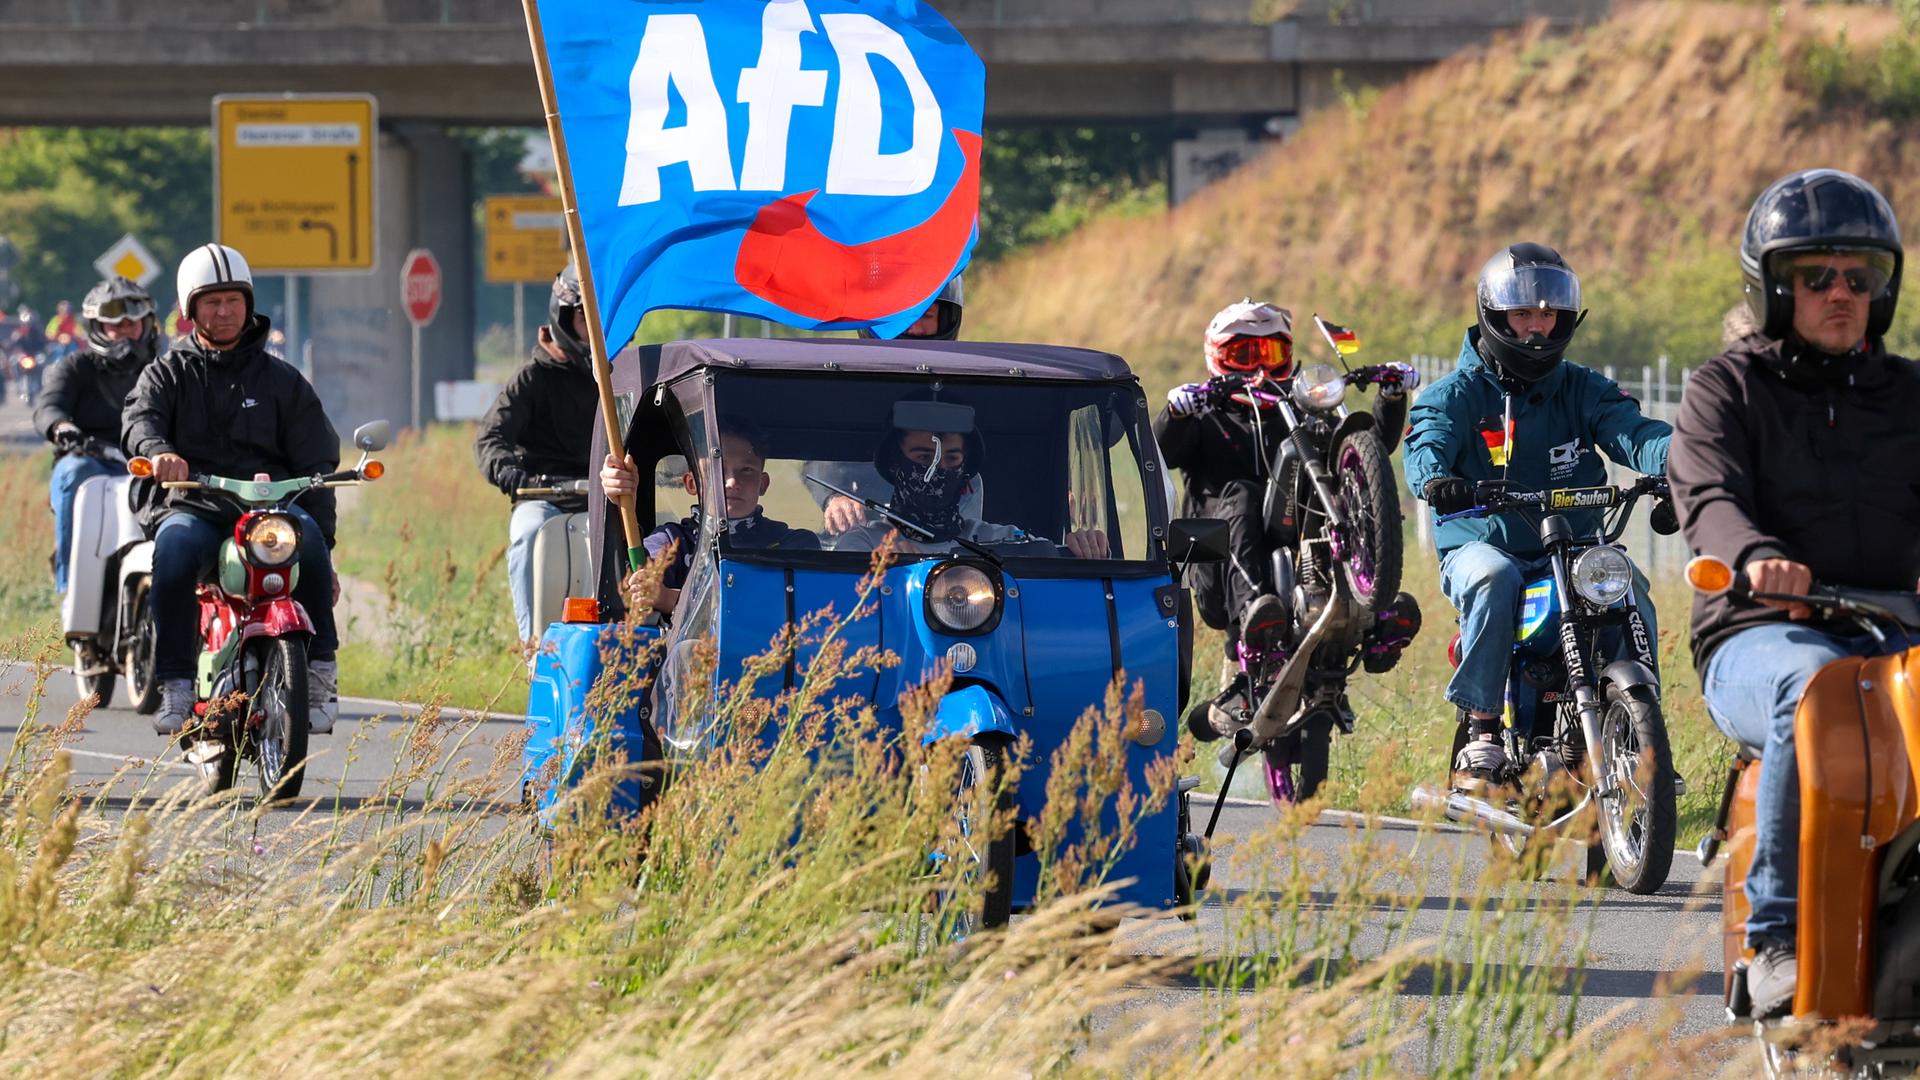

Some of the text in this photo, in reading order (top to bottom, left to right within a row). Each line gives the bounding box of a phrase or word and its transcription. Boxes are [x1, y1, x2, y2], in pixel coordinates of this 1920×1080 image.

[618, 0, 943, 207] AfD
[407, 274, 438, 303] STOP
[1554, 490, 1609, 507] BierSaufen
